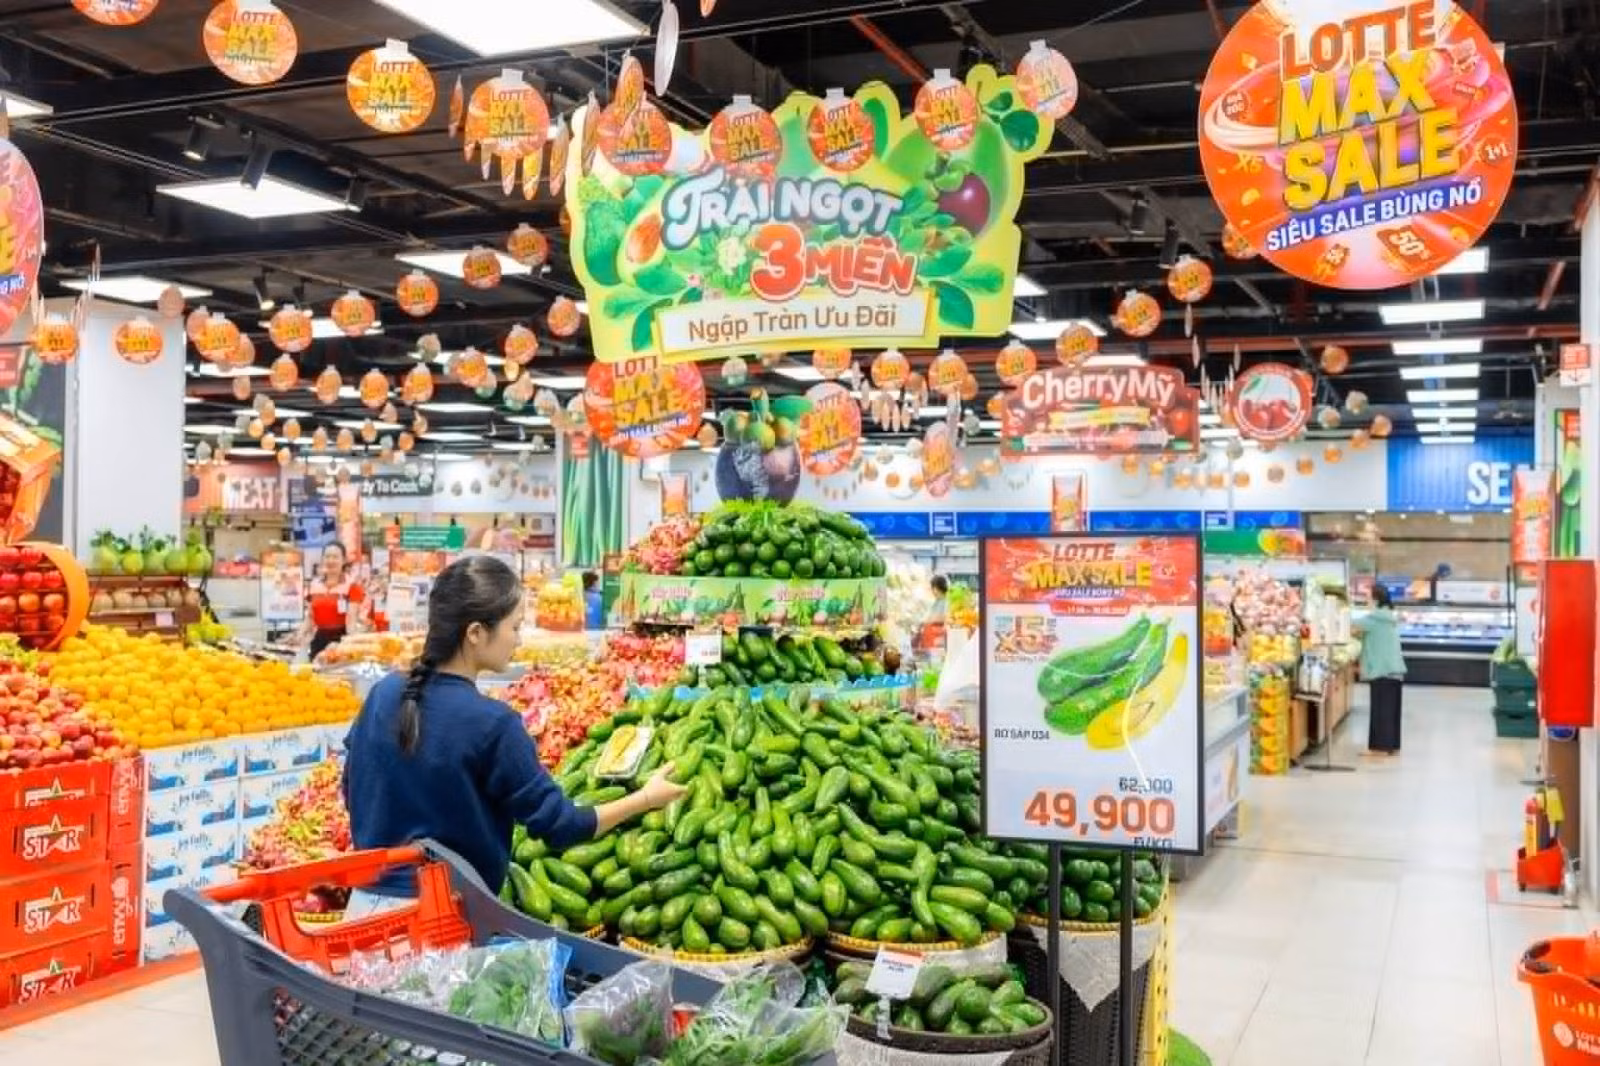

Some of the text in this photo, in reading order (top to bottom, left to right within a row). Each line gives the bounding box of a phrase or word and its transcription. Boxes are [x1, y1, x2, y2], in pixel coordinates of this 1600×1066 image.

[1280, 1, 1437, 81] LOTTE
[1278, 49, 1437, 146] MAX
[1283, 108, 1462, 212] SALE
[775, 178, 903, 236] NGỌT
[1266, 217, 1316, 251] SIÊU
[1320, 206, 1376, 236] SALE
[1380, 189, 1444, 220] BÙNG
[751, 223, 918, 301] 3 MIỀN
[688, 304, 896, 344] Ngập Tràn Ưu Đãi
[613, 356, 657, 379] LOTT
[1467, 465, 1512, 506] SE
[1030, 561, 1152, 588] MAX SALE
[1053, 543, 1116, 562] LOTTE
[1025, 791, 1175, 836] 49,900
